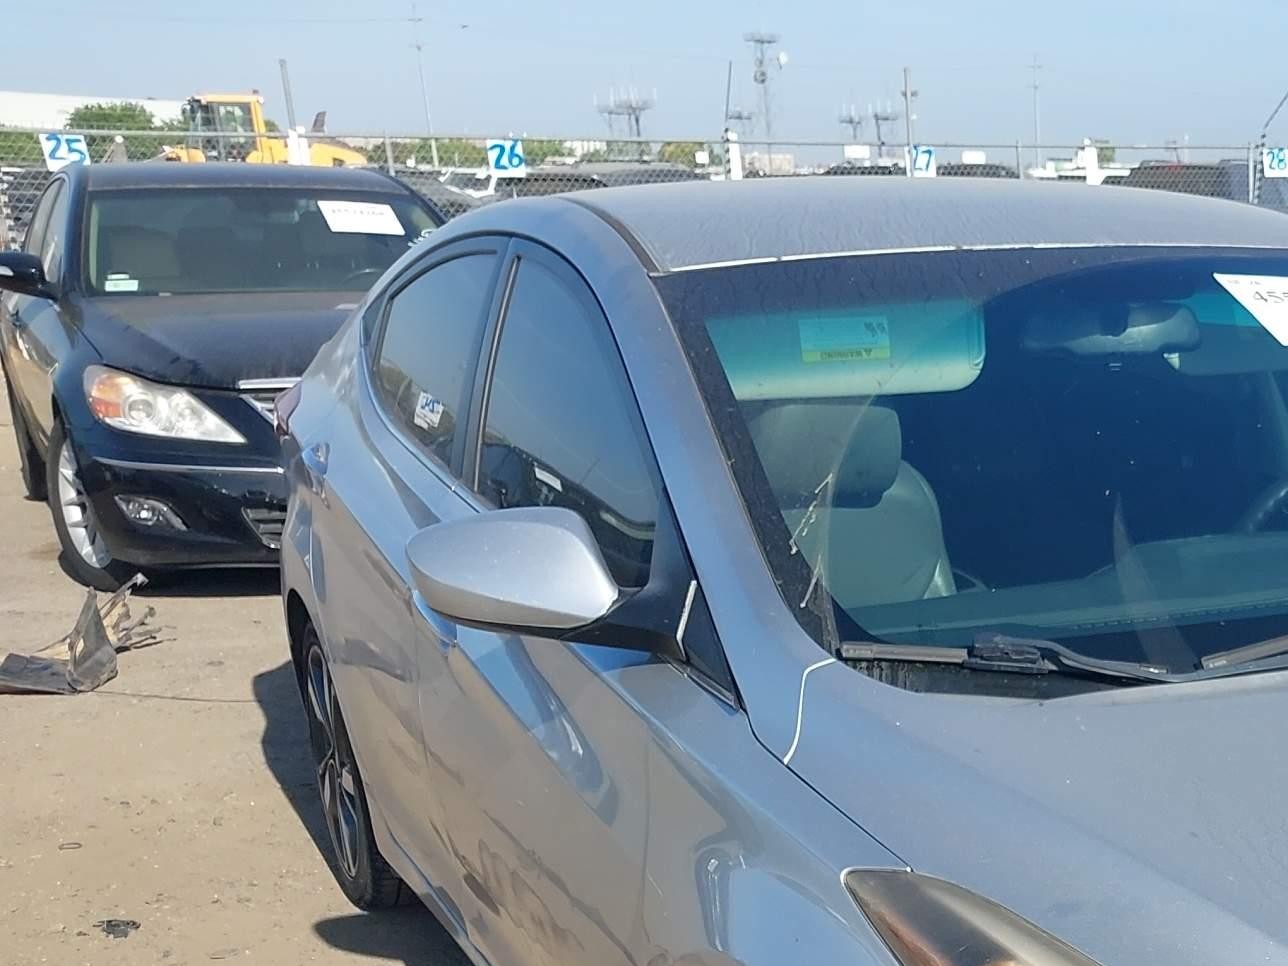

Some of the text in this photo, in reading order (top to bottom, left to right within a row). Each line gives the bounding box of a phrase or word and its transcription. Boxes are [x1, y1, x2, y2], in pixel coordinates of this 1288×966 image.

[46, 133, 86, 165] 25
[488, 139, 524, 169] 26
[1267, 150, 1287, 170] 28
